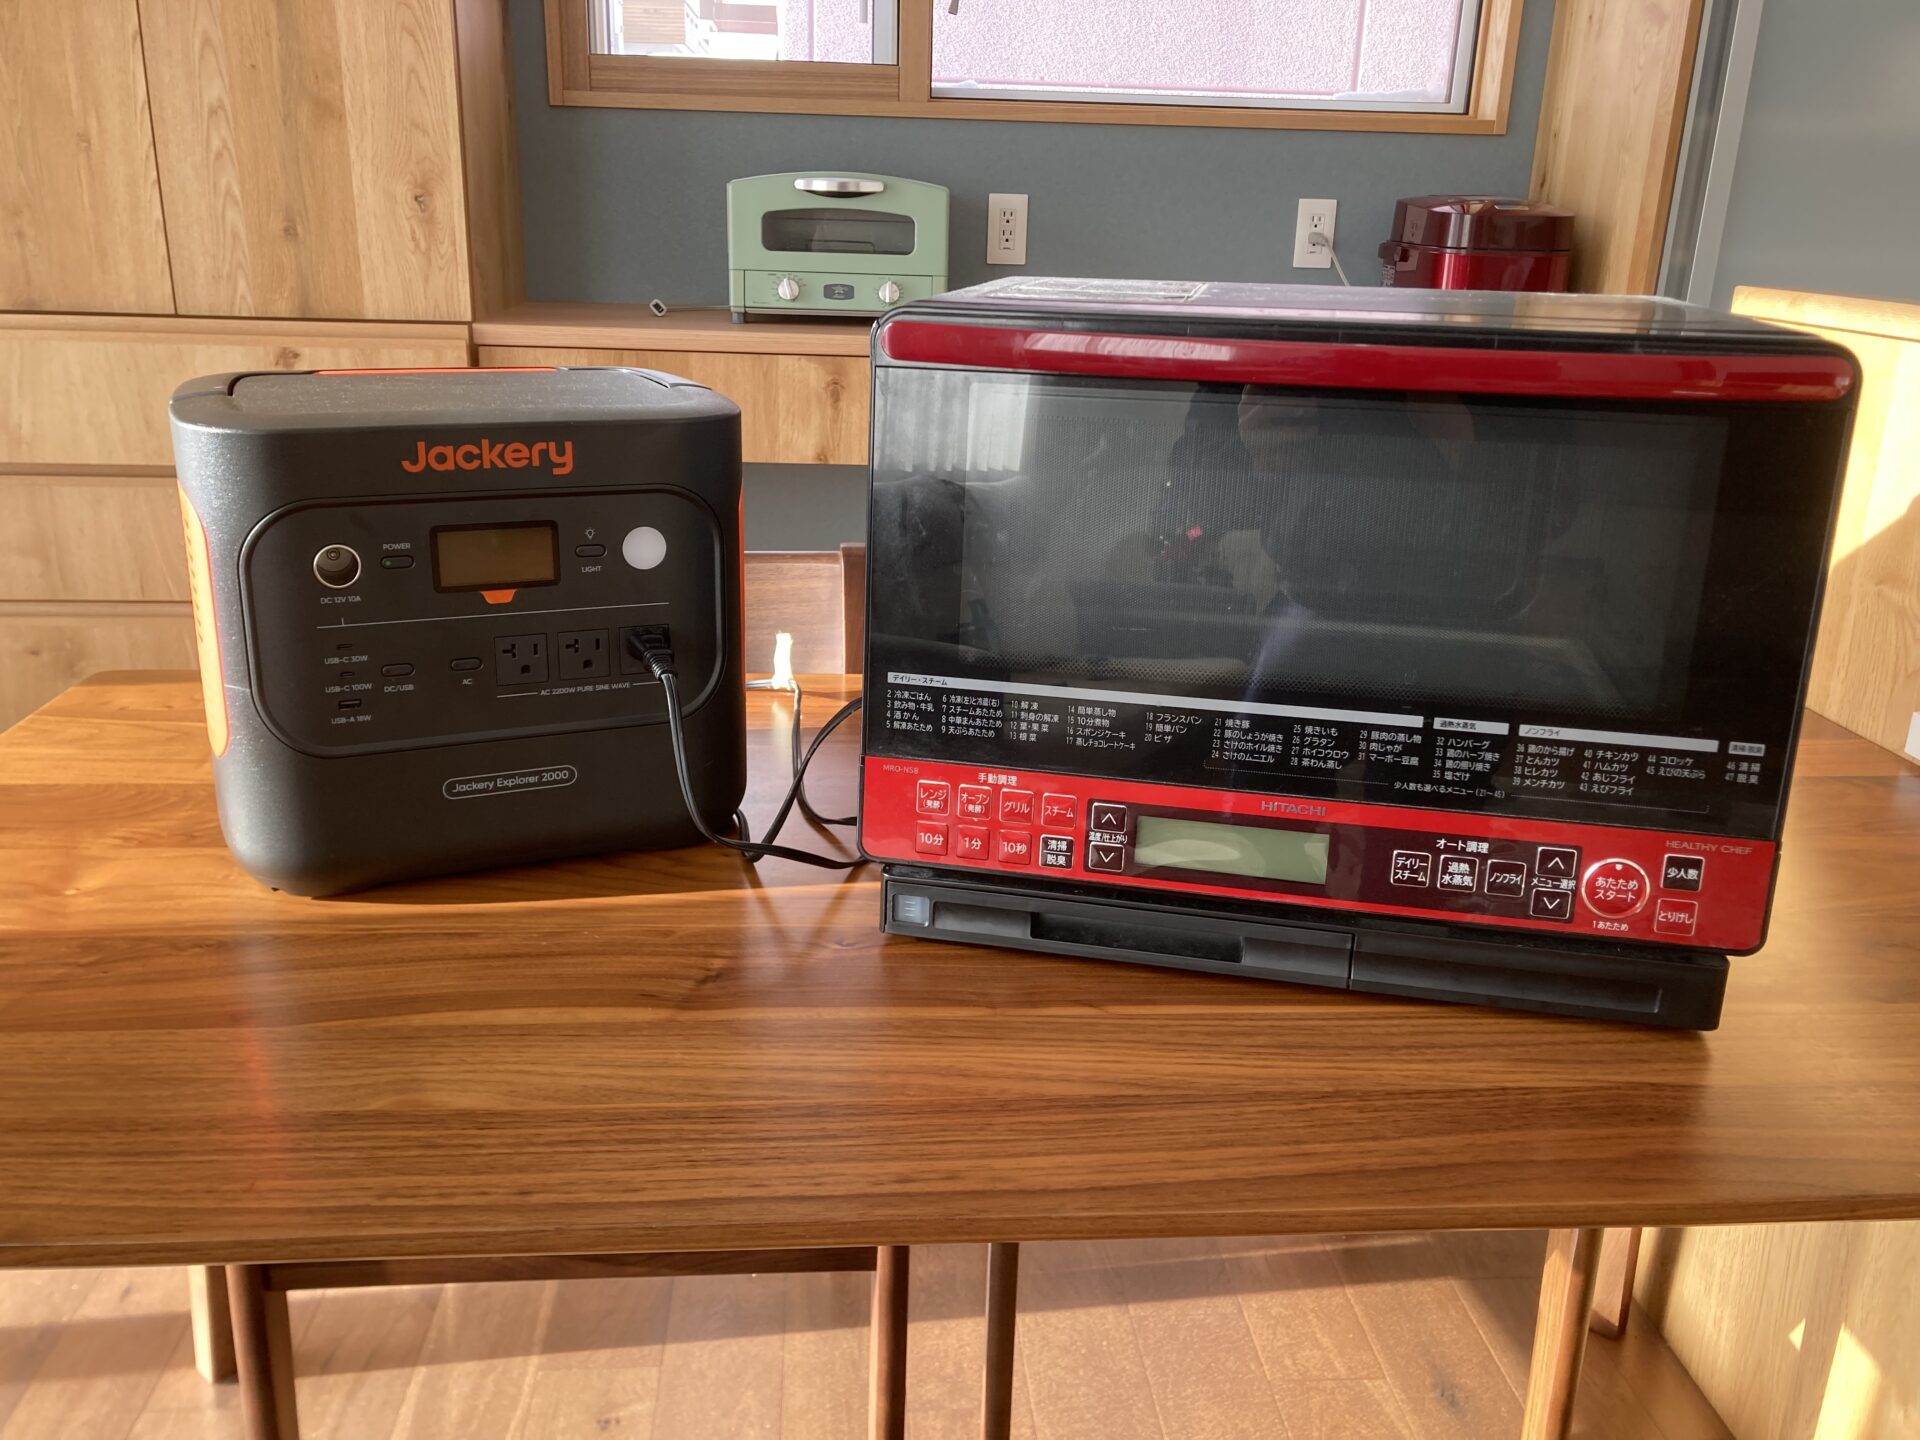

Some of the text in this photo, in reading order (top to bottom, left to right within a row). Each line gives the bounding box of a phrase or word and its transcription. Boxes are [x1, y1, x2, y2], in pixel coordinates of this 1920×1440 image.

[401, 439, 573, 476] Jackery
[382, 542, 411, 551] POWER
[581, 565, 602, 573] LIGHT
[320, 596, 333, 604] DC
[324, 655, 368, 665] USB-C 30W
[325, 683, 372, 693] USB-C 100W
[384, 684, 415, 693] DC/USB
[551, 687, 576, 695] 2200W
[577, 685, 593, 693] PURE
[886, 690, 931, 701] 2 冷凍ごはん
[942, 694, 947, 703] 6
[886, 700, 935, 712] 3 飲み物・牛乳
[1011, 700, 1019, 709] 10
[886, 710, 891, 718] 4
[942, 705, 1003, 718] 7 スチームあたため
[1011, 711, 1059, 723] 11 刺身の解凍
[1068, 705, 1117, 718] 14 簡単蒸し物
[331, 716, 355, 725] USB-A
[941, 715, 1003, 728] 8 中華まんあたため
[1067, 716, 1110, 728] 15 10分煮物
[1146, 712, 1202, 725] 18 フランスパン
[1214, 718, 1250, 729] 21 焼き豚
[1440, 720, 1477, 730] 過熱水蒸気
[886, 721, 933, 732] 5 解凍あたため
[941, 726, 995, 738] 9 天ぷらあたため
[1010, 721, 1017, 730] 12
[1146, 723, 1187, 734] 19 簡単パン
[1293, 724, 1338, 737] 25 焼きいも
[1524, 727, 1561, 737] ノンフライ
[1009, 732, 1017, 740] 13
[1067, 726, 1126, 739] 16 スポンジケーキ
[1144, 734, 1152, 742] 20
[1213, 729, 1284, 743] 22 豚のしょうが焼き
[1360, 730, 1422, 744] 29 豚肉の蒸し物
[1066, 737, 1136, 751] 17 蒸しチョコレートケーキ
[1212, 739, 1283, 754] 23 さけのホイル焼き
[1292, 735, 1336, 747] 26 グラタン
[1358, 741, 1403, 753] 30 肉じゃが
[1436, 736, 1491, 750] 32 ハンバーグ
[1291, 746, 1349, 759] 27 ホイコウロウ
[1434, 747, 1443, 756] 33
[1517, 743, 1576, 757] 36 鶏のから揚げ
[1584, 749, 1639, 762] 40 チキンカツ
[1211, 750, 1275, 764] 24 さけのムニエル
[1290, 757, 1343, 770] 28 茶わん蒸し
[1357, 752, 1419, 766] 31 マーボー豆腐
[1515, 754, 1560, 766] 37 とんカツ
[1647, 754, 1695, 766] 44 コロッケ
[1433, 758, 1491, 772] 34 鶏の照り焼き
[1513, 765, 1559, 778] 38 ヒレカツ
[1582, 760, 1629, 772] 41 ハムカツ
[1432, 770, 1471, 781] 35 塩ざけ
[1580, 772, 1636, 785] 42 あじフライ
[1646, 765, 1706, 779] 45 えびの天ぷら
[452, 770, 569, 793] Jackery Explorer 2000
[977, 772, 1018, 786] 手動調理
[1512, 777, 1566, 789] 39 メンチカツ
[920, 788, 947, 800] レンジ
[1580, 782, 1635, 796] 43 えびフライ
[961, 792, 990, 804] オーブン
[1003, 801, 1030, 814] グリル
[1045, 806, 1074, 818] スチーム
[1261, 800, 1327, 817] HITACHI
[920, 833, 944, 846] 10分
[964, 837, 981, 850] 1分
[1089, 831, 1128, 844] 温度/仕上がり
[1002, 842, 1027, 854] 10秒
[1047, 840, 1067, 851] 清掃
[1435, 838, 1489, 854] オート調理
[1665, 840, 1753, 855] HEALTHY CHEF
[1046, 855, 1066, 866] 脱臭
[1396, 856, 1428, 869] デイリー
[1447, 861, 1470, 874] 過熱
[1666, 867, 1699, 880] 少人数
[1394, 870, 1426, 882] スチーム
[1441, 874, 1473, 887] 水蒸気
[1489, 872, 1522, 885] ノンフライ
[1530, 877, 1577, 890] メニュー選択
[1595, 877, 1639, 890] あたため
[1594, 889, 1636, 903] スタート
[1658, 911, 1694, 924] とりけし
